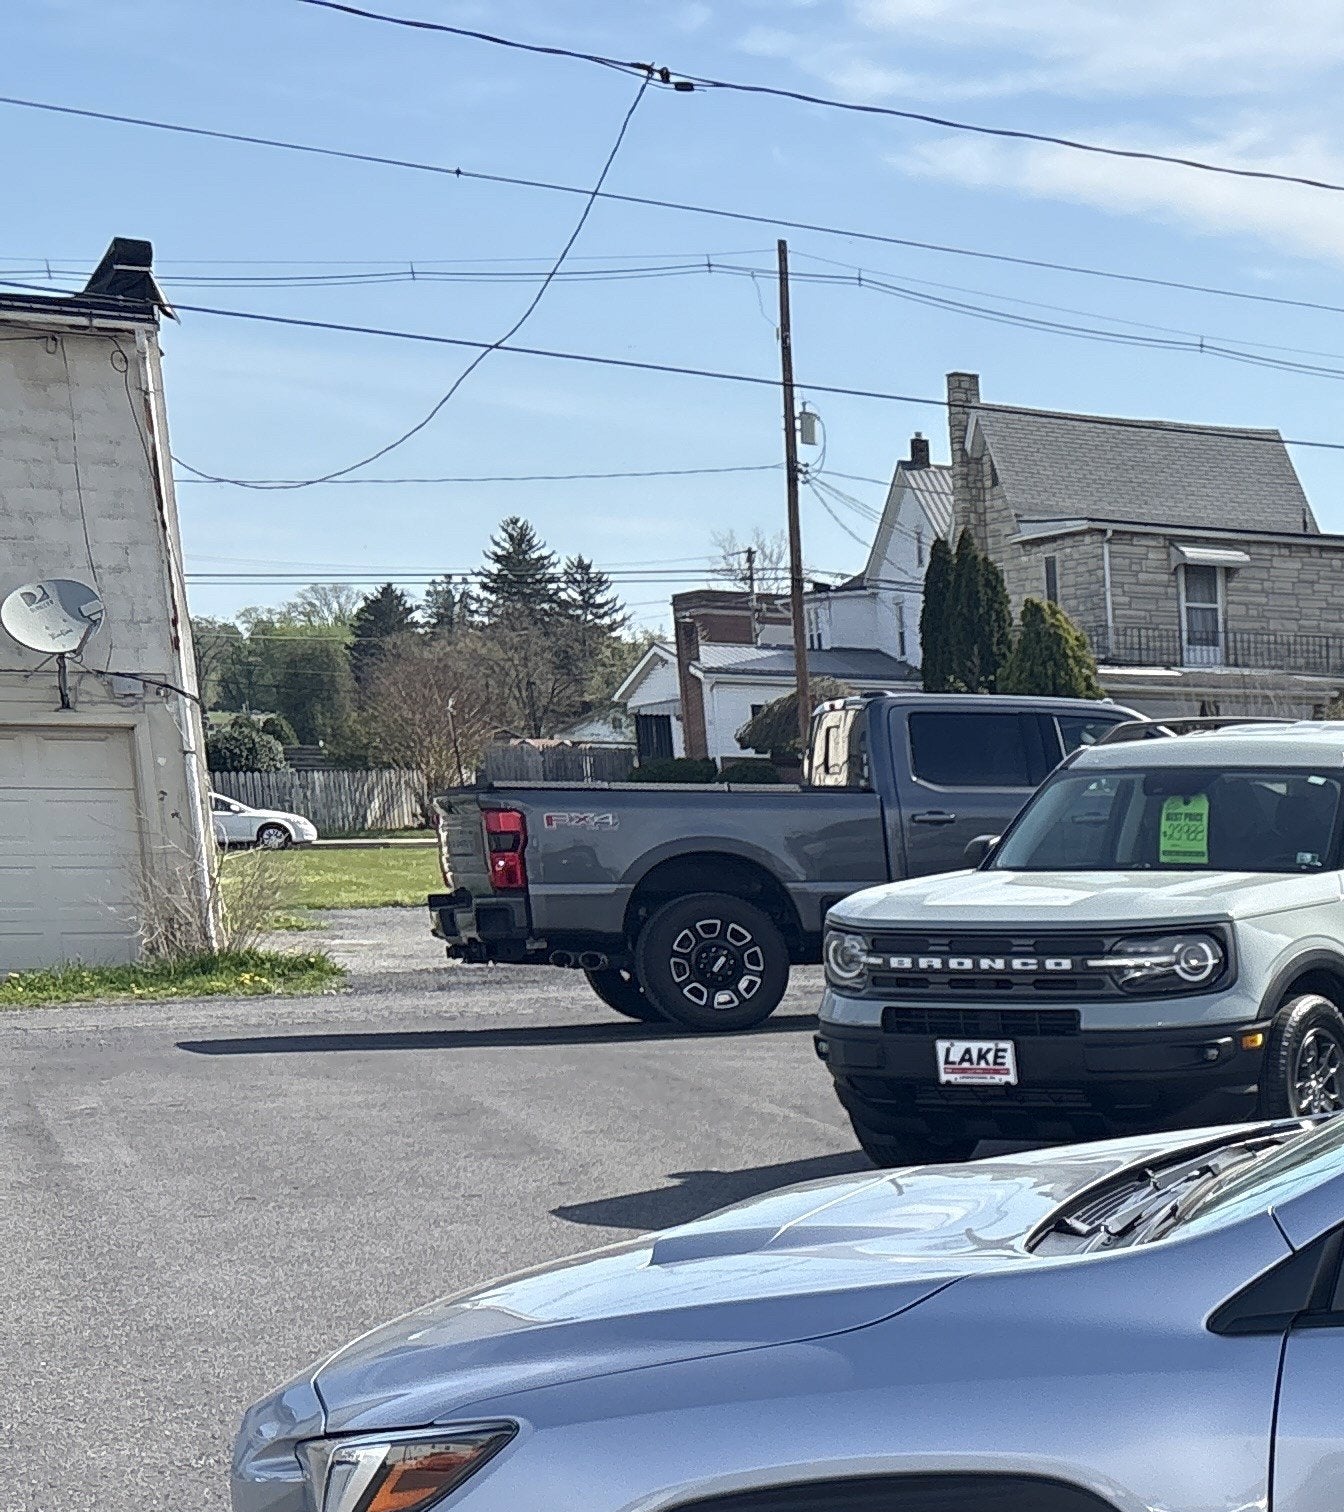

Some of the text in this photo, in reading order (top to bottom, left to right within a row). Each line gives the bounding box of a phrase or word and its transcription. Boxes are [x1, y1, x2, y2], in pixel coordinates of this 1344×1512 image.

[544, 812, 619, 830] FX4
[889, 956, 1073, 970] BRONCO
[944, 1047, 1009, 1066] LAKE
